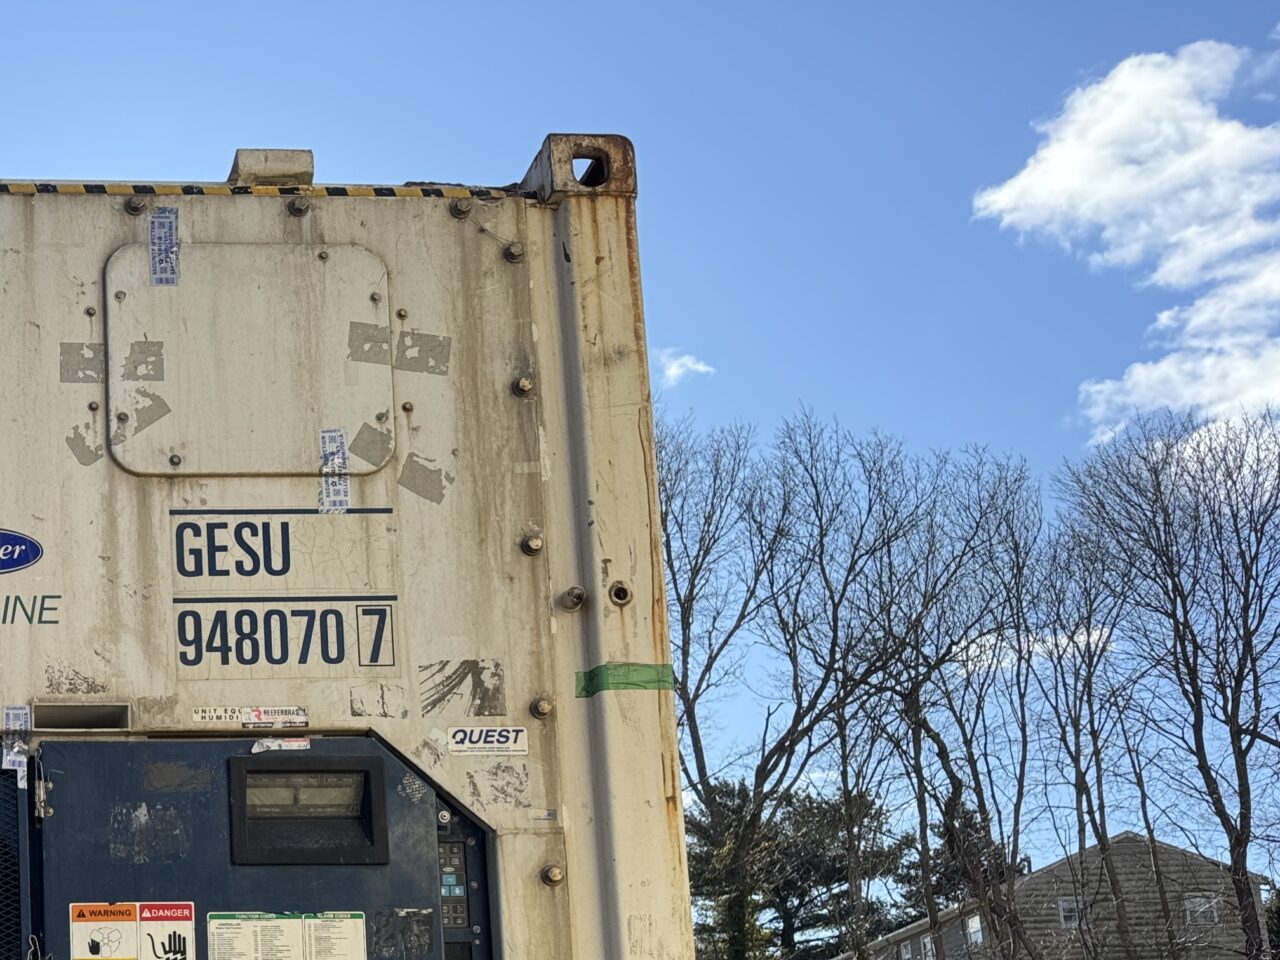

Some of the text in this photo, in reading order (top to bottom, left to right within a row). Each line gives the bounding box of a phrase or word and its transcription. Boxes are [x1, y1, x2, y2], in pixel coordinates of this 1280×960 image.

[175, 521, 291, 578] GESU
[177, 608, 388, 667] 948070 7
[452, 728, 524, 745] QUEST
[89, 909, 132, 917] WARNING
[151, 909, 190, 917] DANGER
